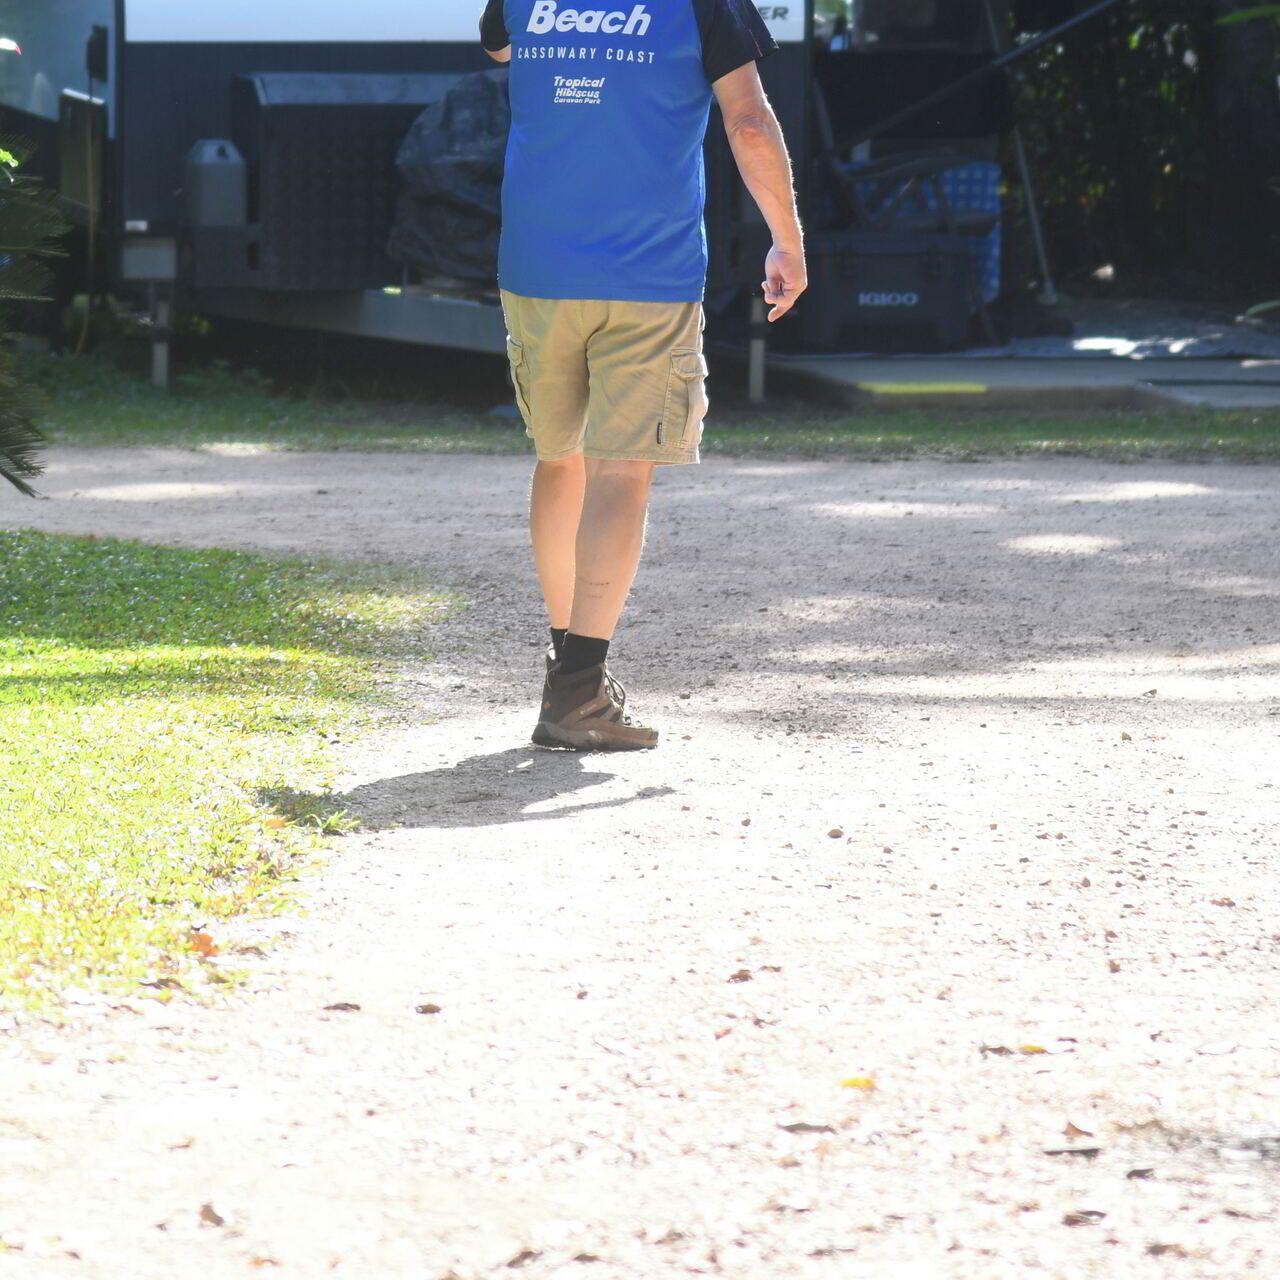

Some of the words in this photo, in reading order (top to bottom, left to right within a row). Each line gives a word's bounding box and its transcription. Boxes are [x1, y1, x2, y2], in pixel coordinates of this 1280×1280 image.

[526, 0, 652, 36] Beach
[517, 46, 597, 60] CASSOWARY
[606, 47, 656, 64] COAST
[553, 75, 606, 89] Tropical
[555, 87, 601, 99] Hibiscus
[553, 96, 584, 104] Caravan
[583, 97, 601, 105] Park
